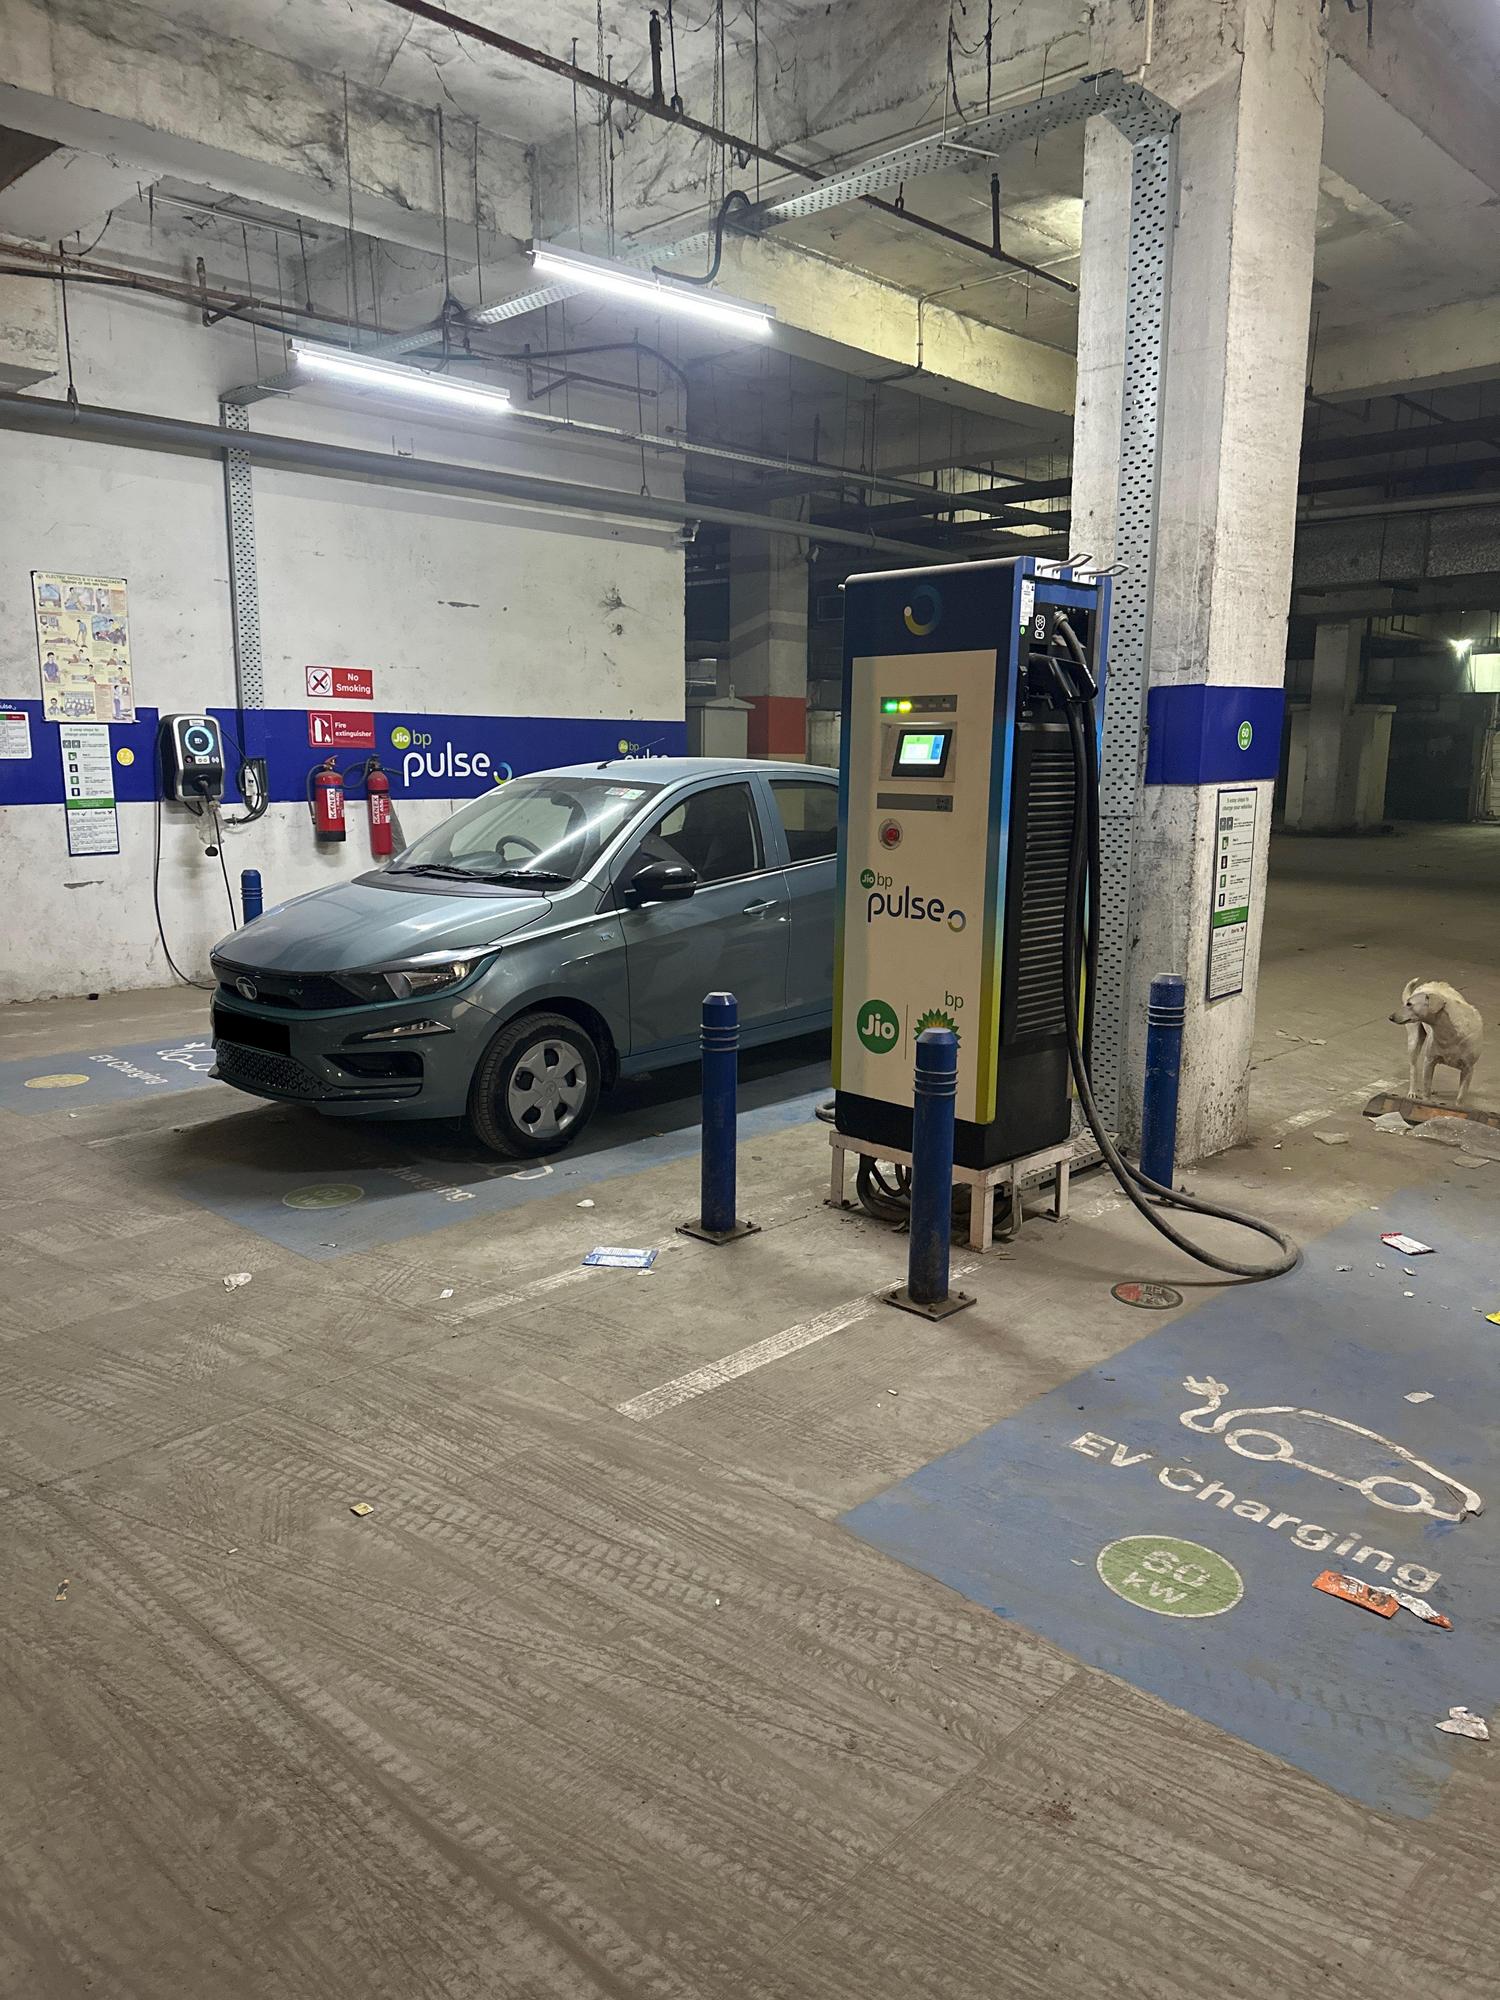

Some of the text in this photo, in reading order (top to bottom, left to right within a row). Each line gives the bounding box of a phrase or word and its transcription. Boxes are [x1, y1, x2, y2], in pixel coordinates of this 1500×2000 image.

[347, 673, 359, 682] No
[336, 683, 371, 695] Smoking
[335, 730, 372, 738] extinguisher
[393, 729, 432, 749] Jio bp
[1241, 728, 1249, 738] 60
[629, 741, 640, 753] bp
[403, 741, 491, 787] pulse
[861, 872, 893, 890] Jio bp
[867, 886, 945, 923] pulse
[944, 991, 964, 1011] bp
[862, 1014, 896, 1040] Jio
[1068, 1431, 1442, 1593] EV Charging
[1142, 1550, 1211, 1588] 60
